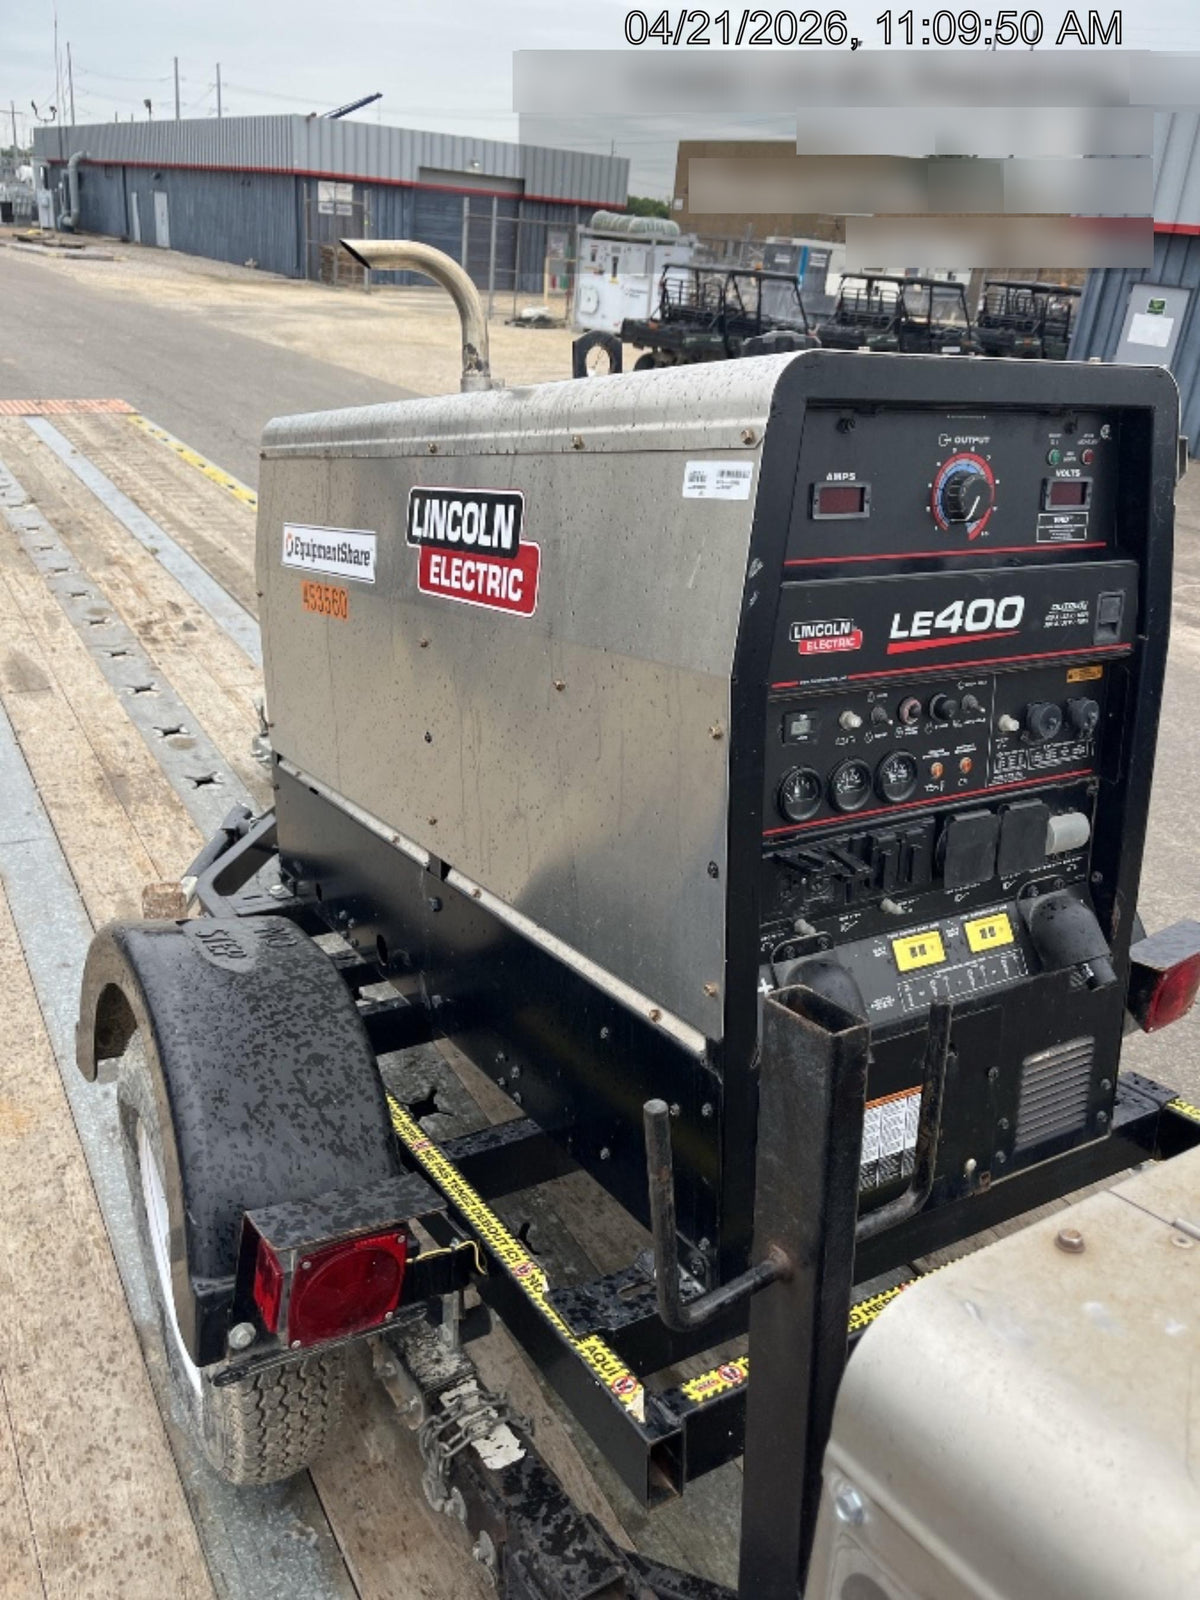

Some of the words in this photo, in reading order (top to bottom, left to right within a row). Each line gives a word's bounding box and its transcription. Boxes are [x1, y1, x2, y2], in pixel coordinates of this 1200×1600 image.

[954, 436, 990, 444] OUTPUT
[826, 472, 856, 481] AMPS
[1056, 469, 1080, 477] VOLTS
[412, 498, 515, 549] LINCOLN
[294, 539, 370, 566] EquipmentShare
[429, 554, 524, 602] ELECTRIC
[793, 622, 851, 639] LINCOLN
[889, 596, 1025, 639] LE400
[806, 636, 857, 652] ELECTRIC
[470, 1207, 509, 1249] DEBOUT
[584, 1344, 618, 1378] AQUI
